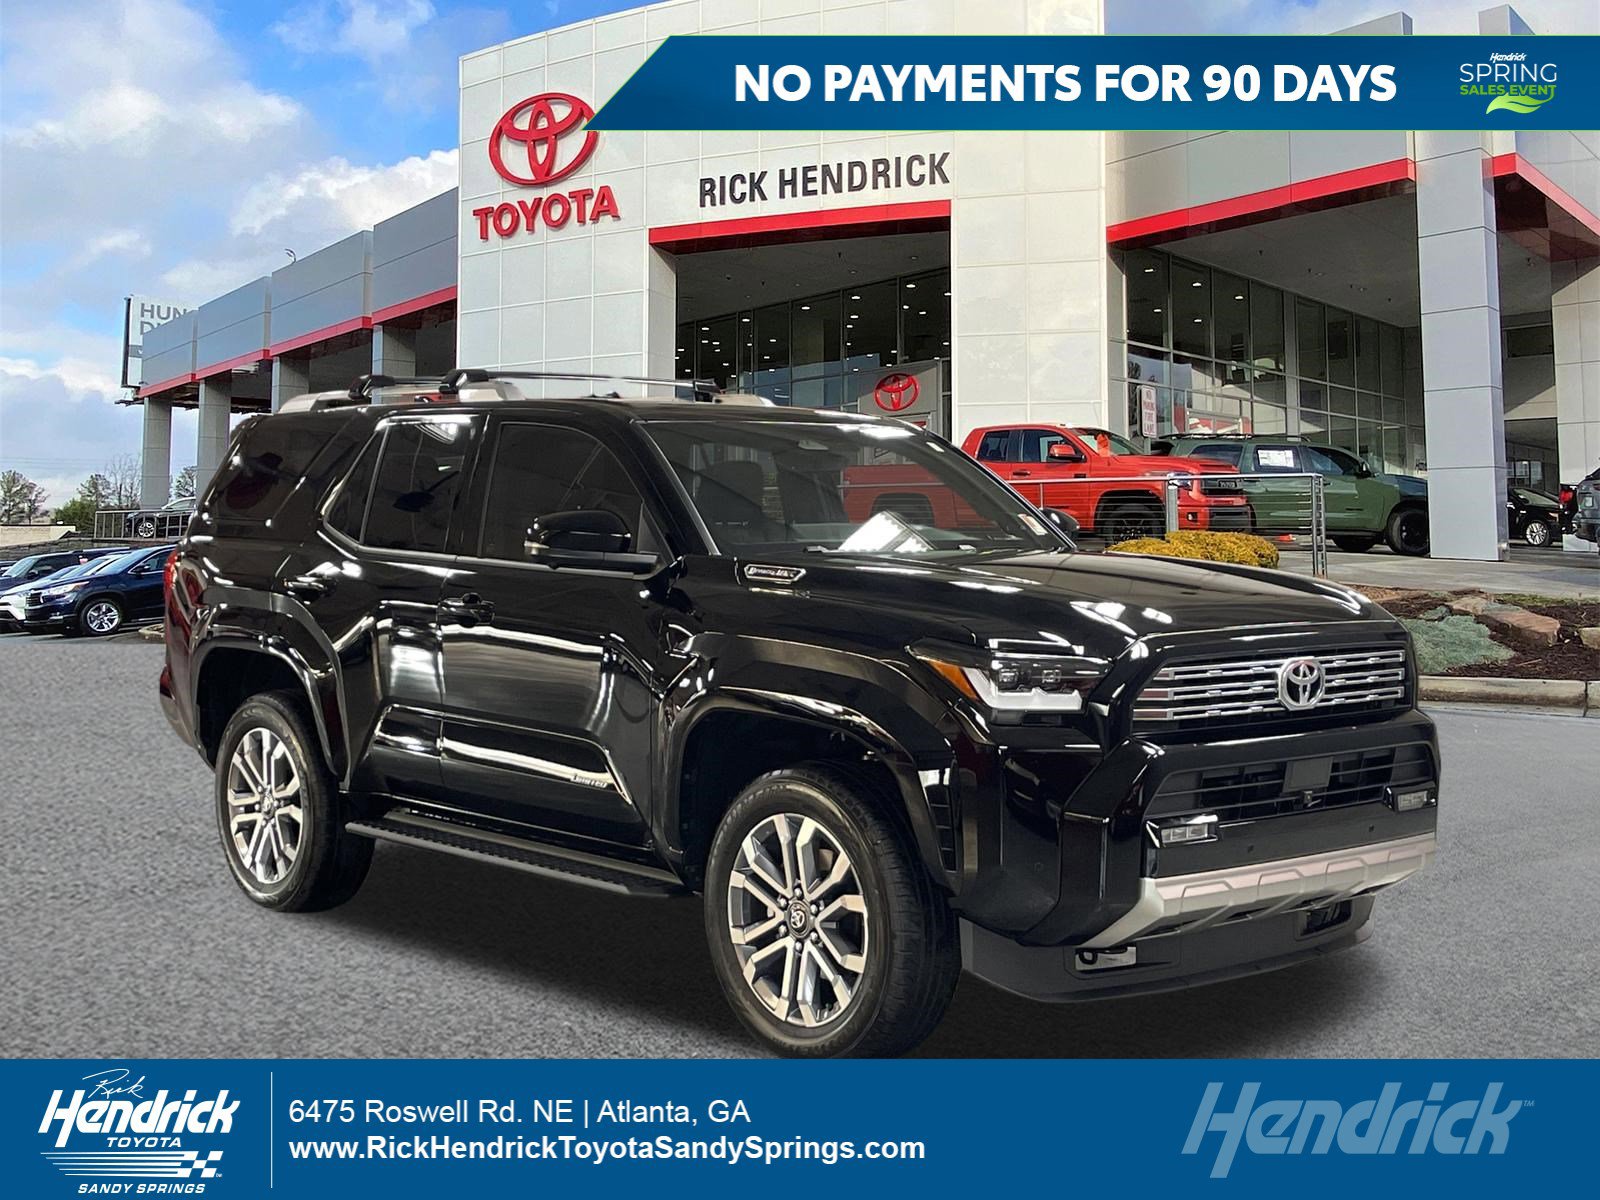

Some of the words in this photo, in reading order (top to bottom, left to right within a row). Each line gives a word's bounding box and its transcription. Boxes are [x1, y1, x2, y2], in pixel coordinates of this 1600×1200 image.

[699, 169, 769, 209] RICK
[778, 151, 951, 200] HENDRICK
[473, 184, 621, 241] TOYOTA
